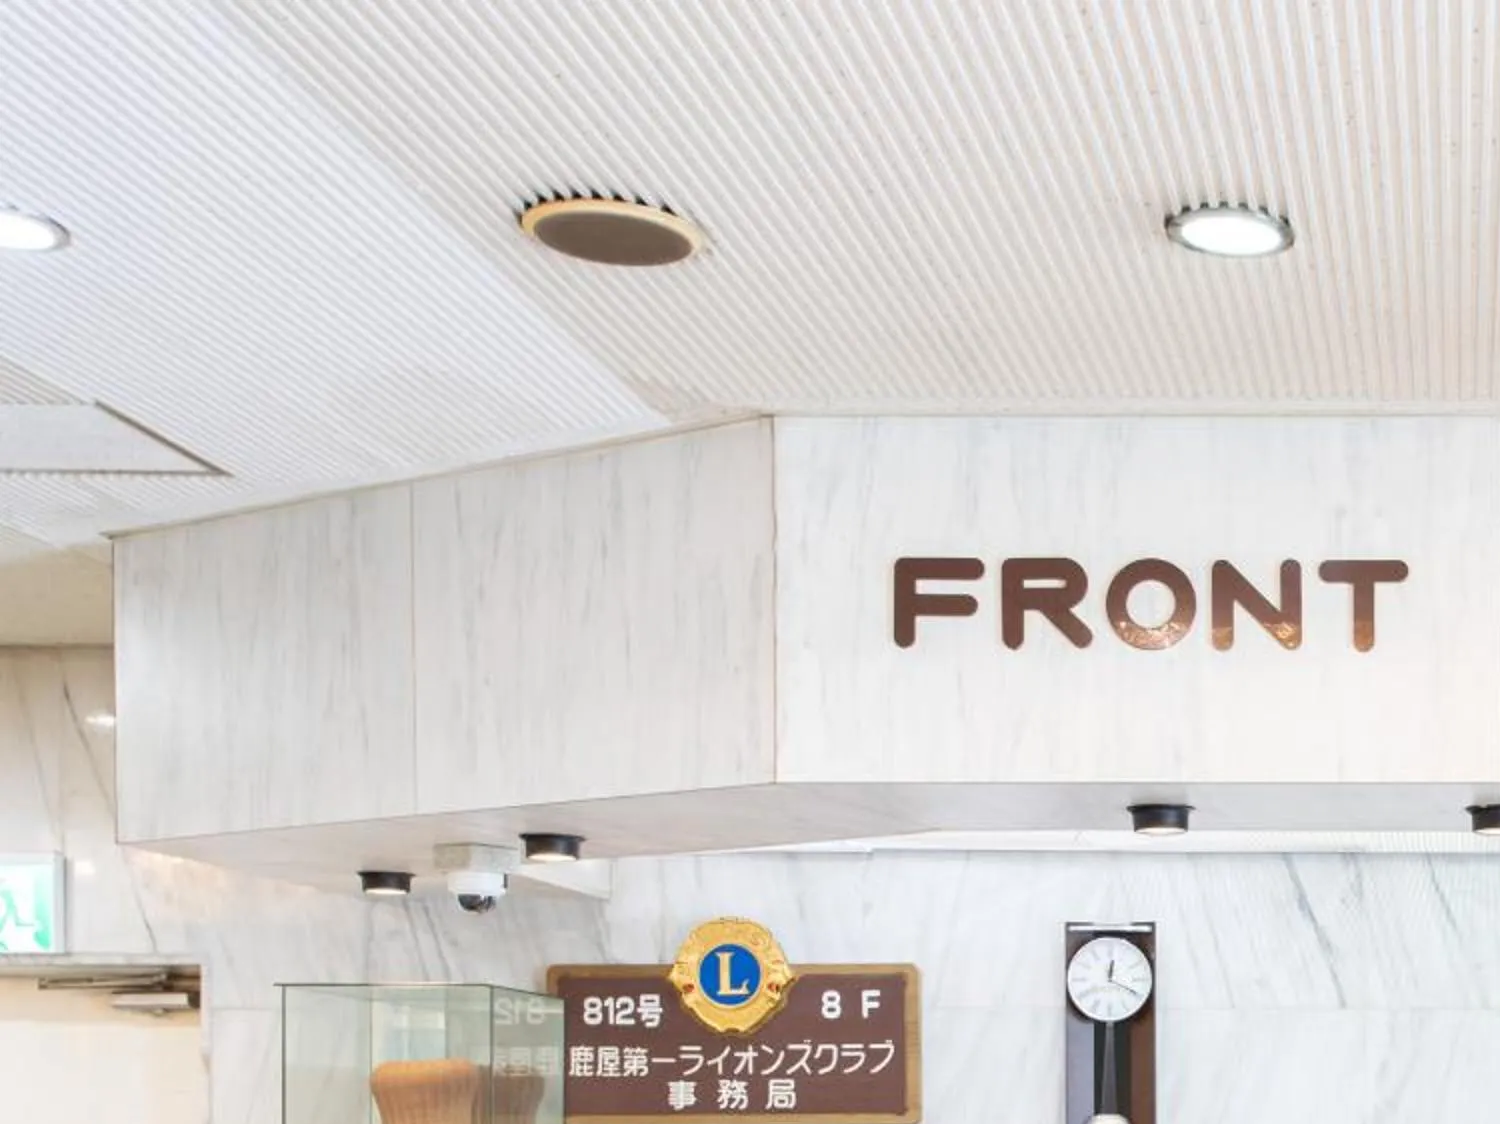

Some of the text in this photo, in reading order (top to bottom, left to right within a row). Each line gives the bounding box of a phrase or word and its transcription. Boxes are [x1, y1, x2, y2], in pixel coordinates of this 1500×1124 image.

[894, 557, 1408, 652] FRONT
[715, 951, 749, 996] L
[583, 994, 663, 1027] 812号
[568, 1039, 895, 1077] 鹿屋第一ライオンズクラブ
